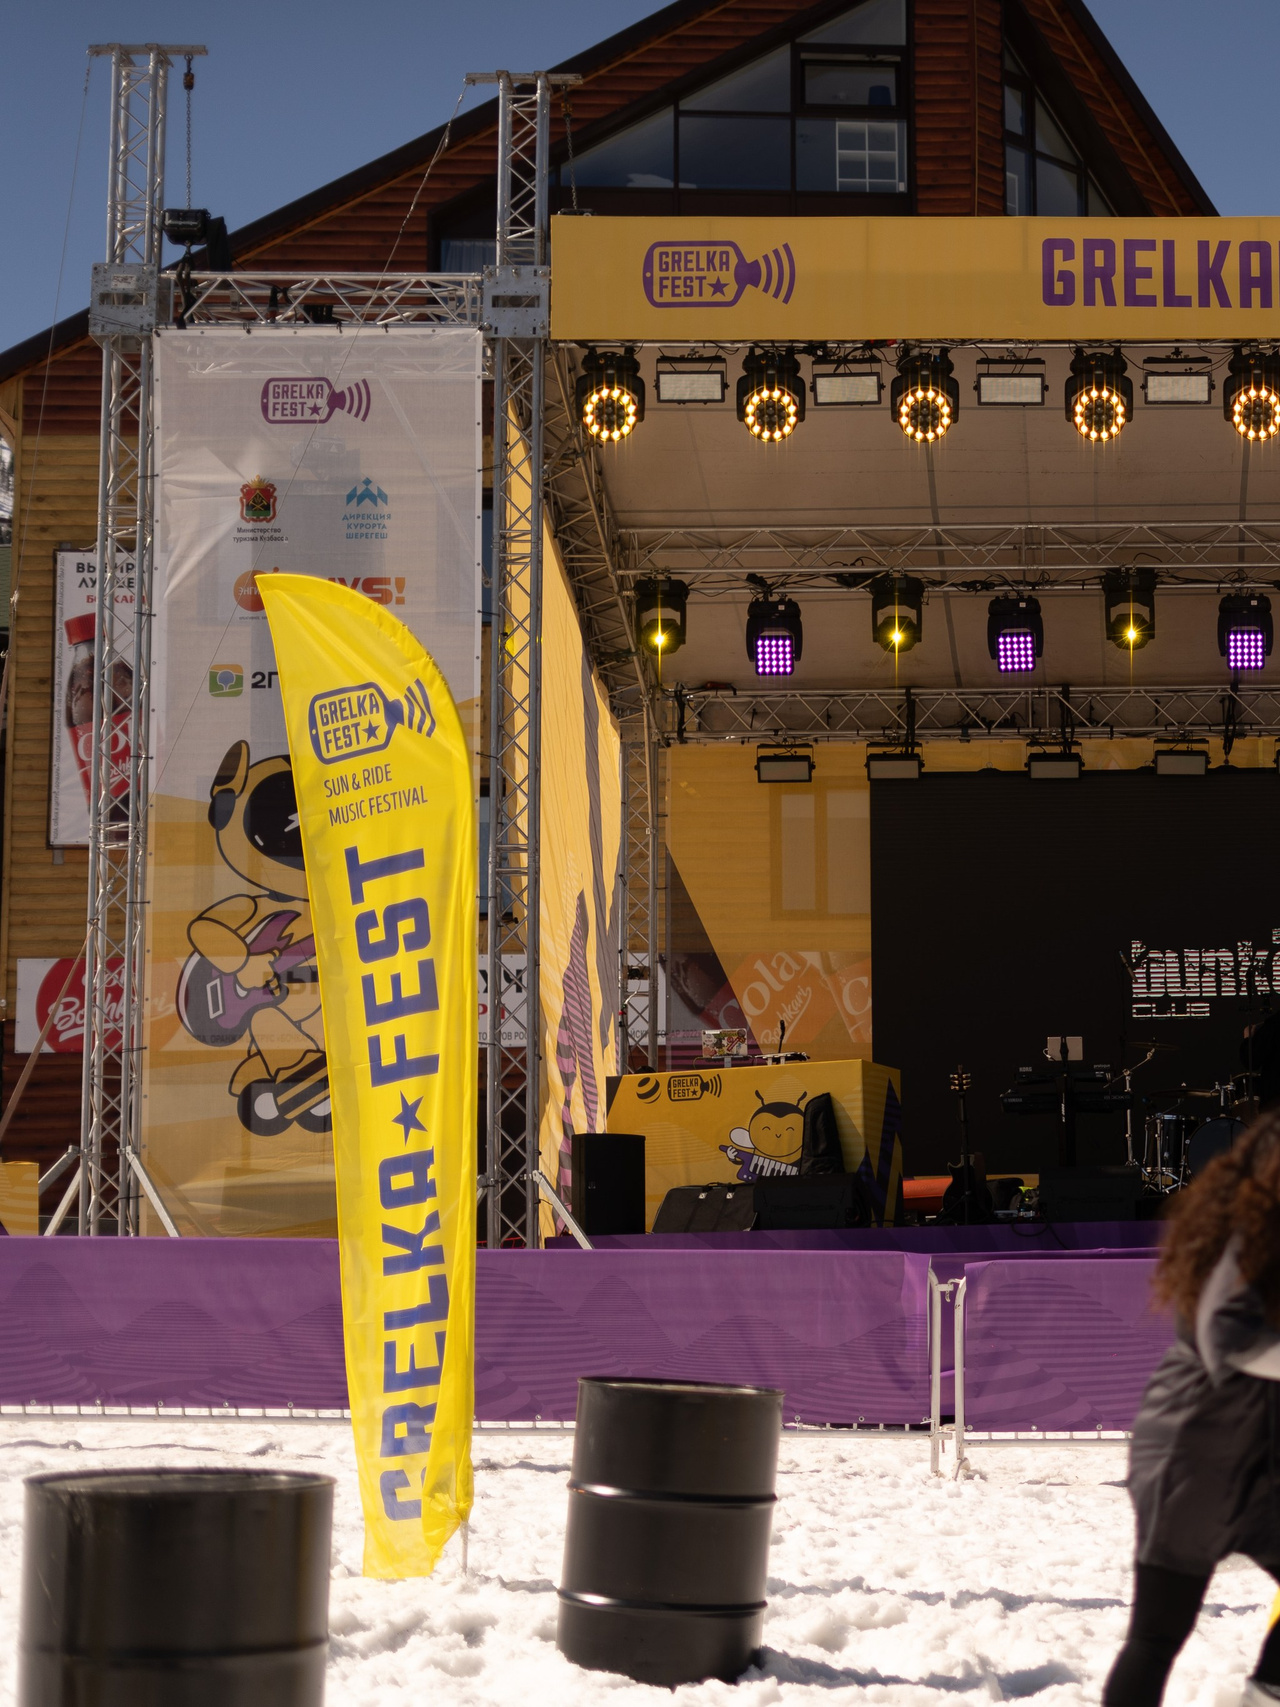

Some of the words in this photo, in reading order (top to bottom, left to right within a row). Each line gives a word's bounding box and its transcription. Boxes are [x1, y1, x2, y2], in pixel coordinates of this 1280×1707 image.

[658, 251, 730, 272] GRELKA
[658, 276, 707, 297] FEST
[272, 384, 324, 399] GRELKA
[272, 402, 307, 417] FEST
[342, 513, 391, 521] ДИРЕКЦИЯ
[318, 692, 380, 727] GRELKA
[323, 722, 361, 754] FEST
[324, 774, 349, 798] SUN
[351, 773, 361, 790] &
[362, 763, 393, 787] RIDE
[328, 800, 367, 827] MUSIC
[368, 785, 428, 816] FESTIVAL
[344, 846, 440, 1088] FEST
[1132, 1003, 1210, 1018] CLUB
[673, 1078, 698, 1088] GRELKA
[673, 1088, 690, 1098] FEST
